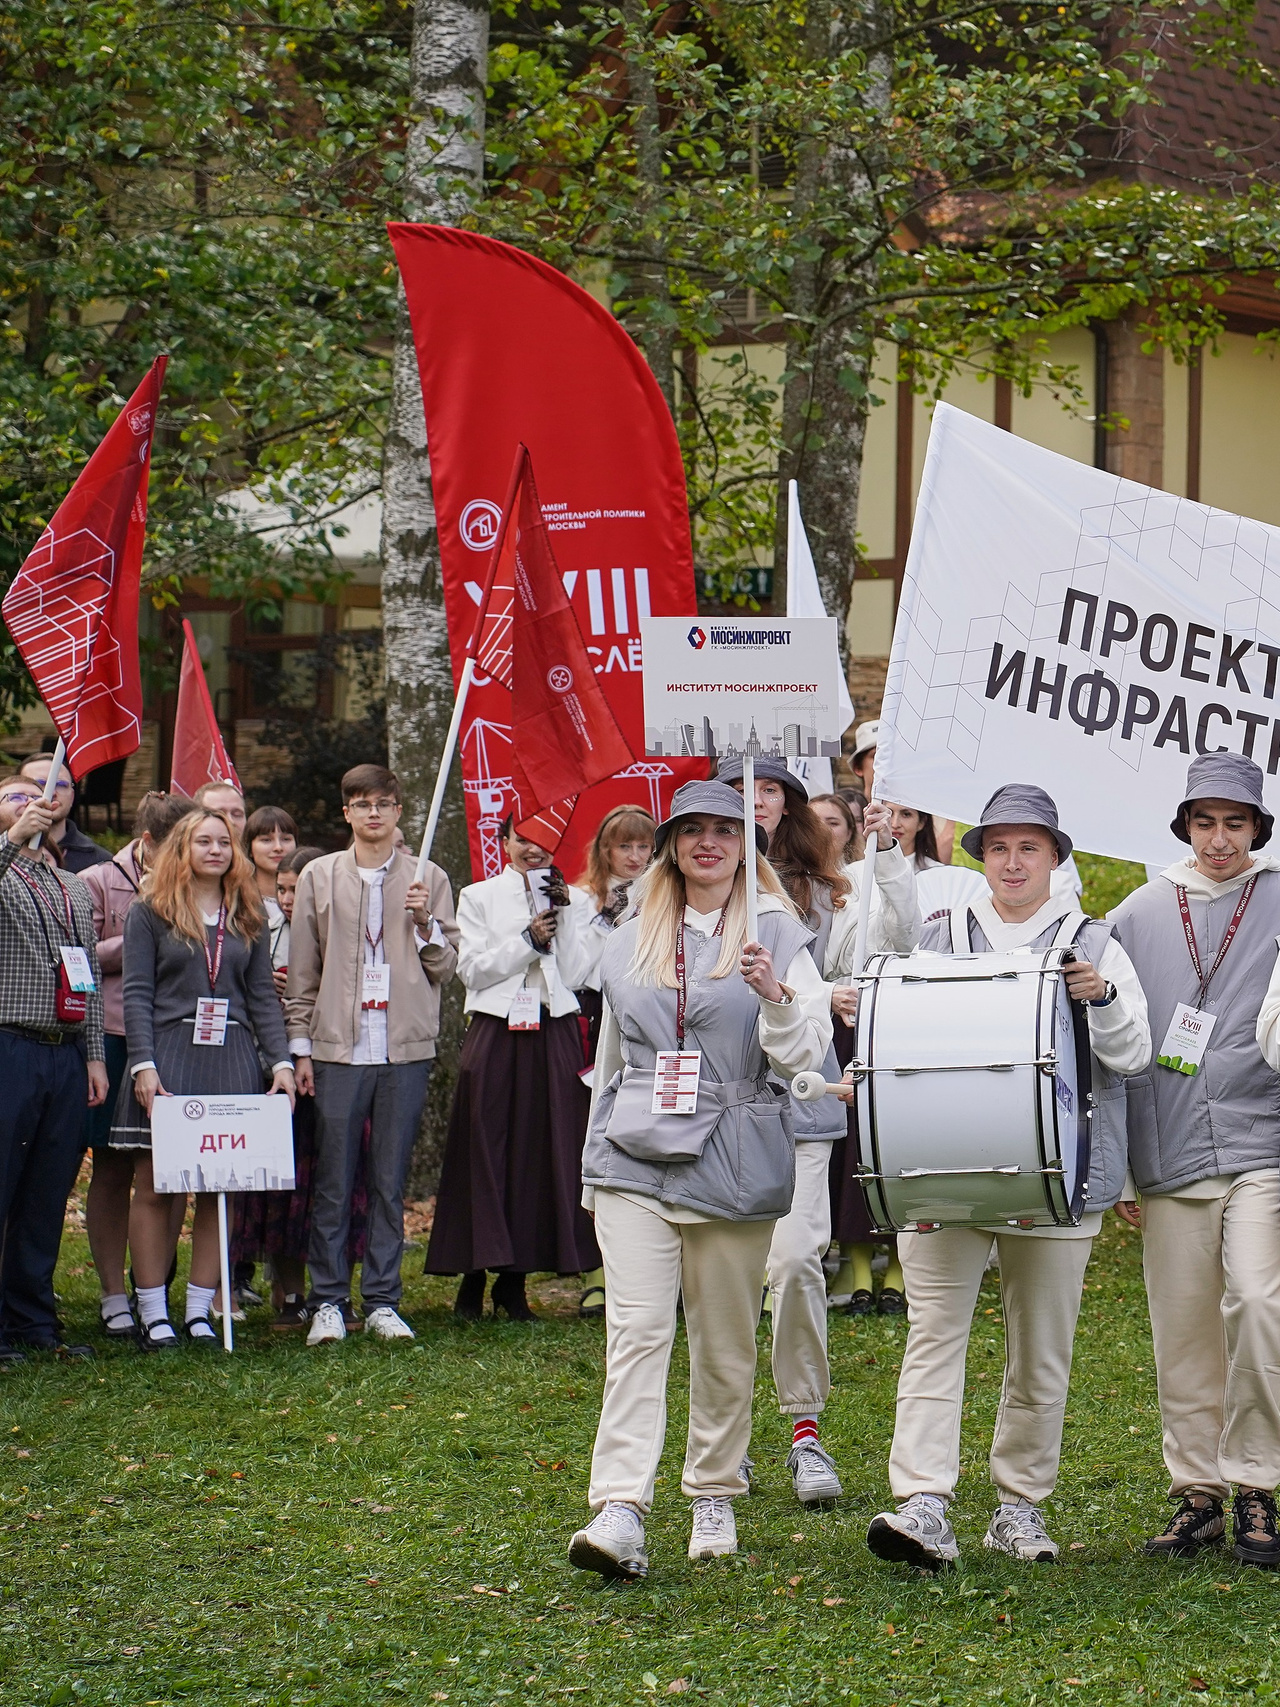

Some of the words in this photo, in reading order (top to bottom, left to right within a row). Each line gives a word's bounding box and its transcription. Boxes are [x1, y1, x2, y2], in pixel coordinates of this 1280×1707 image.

[541, 503, 568, 512] АМЕНТ
[543, 509, 602, 521] ТРОИТЕЛЬНОЙ
[603, 510, 646, 518] ПОЛИТИКИ
[548, 521, 586, 531] МОСКВЫ
[711, 631, 791, 645] МОСИНЖПРОЕКТ
[666, 683, 723, 693] ИНСТИТУТ
[724, 683, 818, 693] МОСИНЖПРОЕКТ
[1181, 1018, 1202, 1031] XVIII
[200, 1134, 246, 1153] ДГИ
